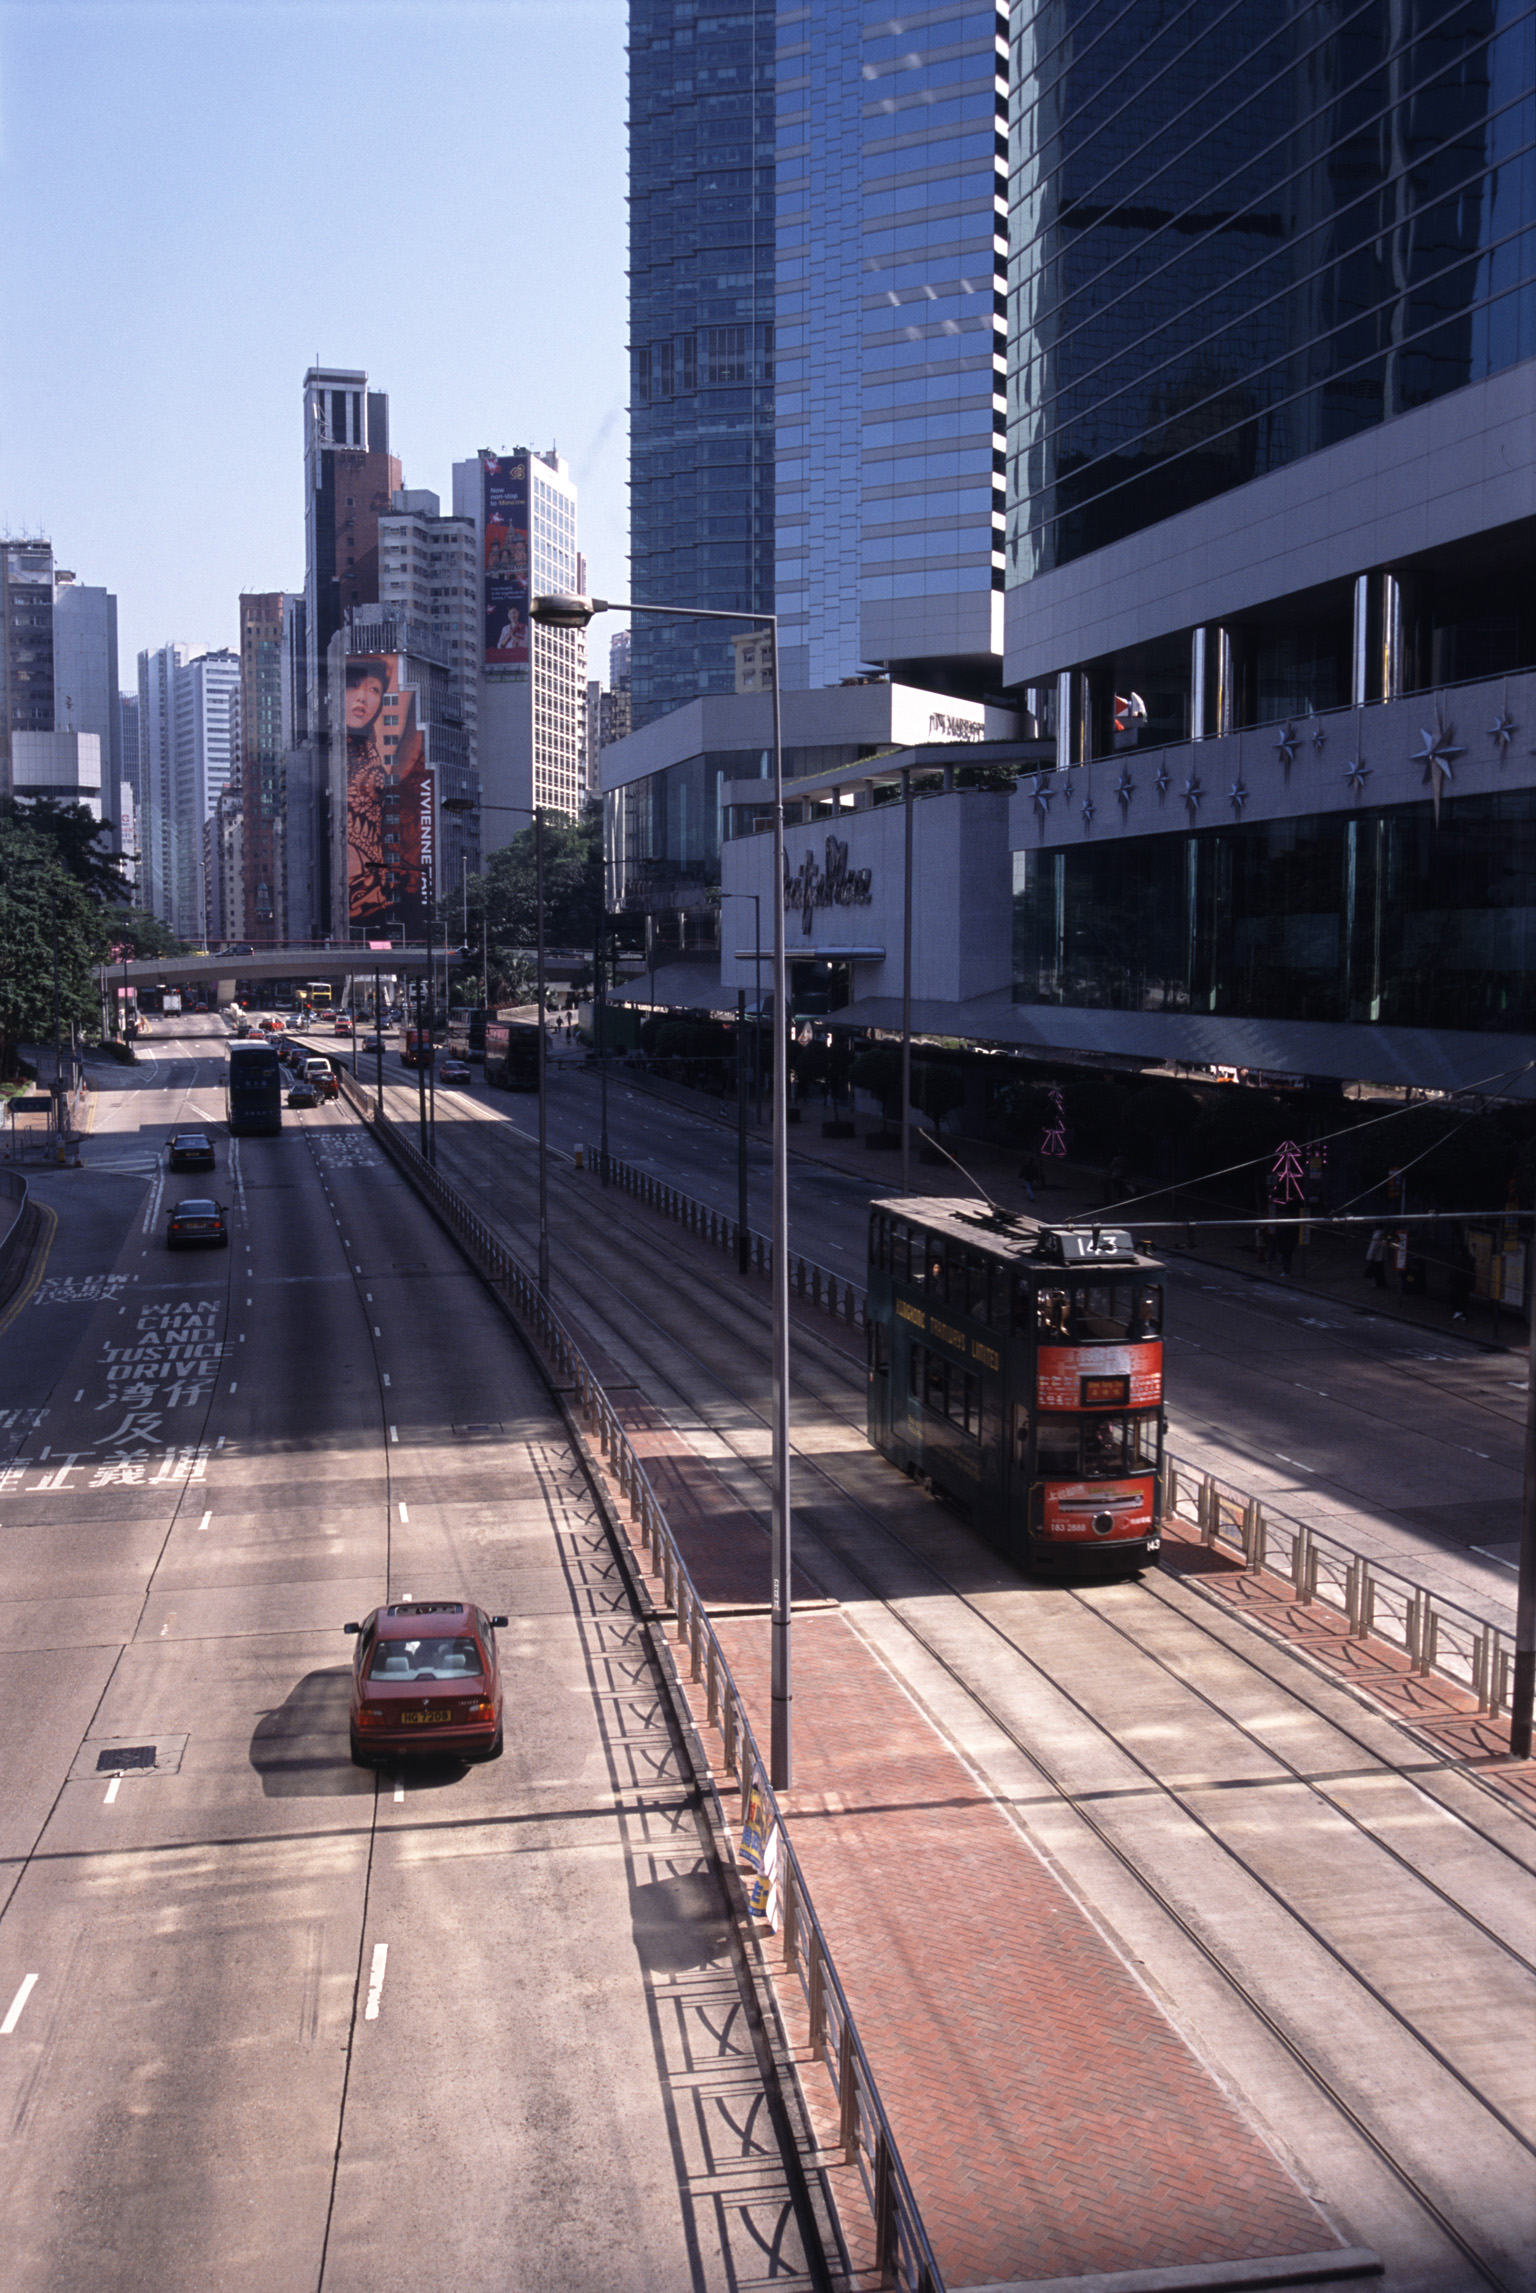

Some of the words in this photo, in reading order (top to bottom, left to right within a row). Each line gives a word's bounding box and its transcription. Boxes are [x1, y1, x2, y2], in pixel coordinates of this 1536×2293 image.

[420, 778, 432, 864] VIVIENNE
[1077, 1236, 1118, 1256] 143
[42, 1273, 130, 1288] SLOW
[141, 1301, 221, 1315] WAN
[137, 1314, 216, 1330] CHAI
[138, 1329, 215, 1345] AND
[97, 1342, 235, 1363] JUSTICE
[106, 1360, 222, 1381] DRIVE
[93, 1412, 163, 1445] 及
[25, 1445, 212, 1491] 正義道
[1147, 1540, 1161, 1551] 143
